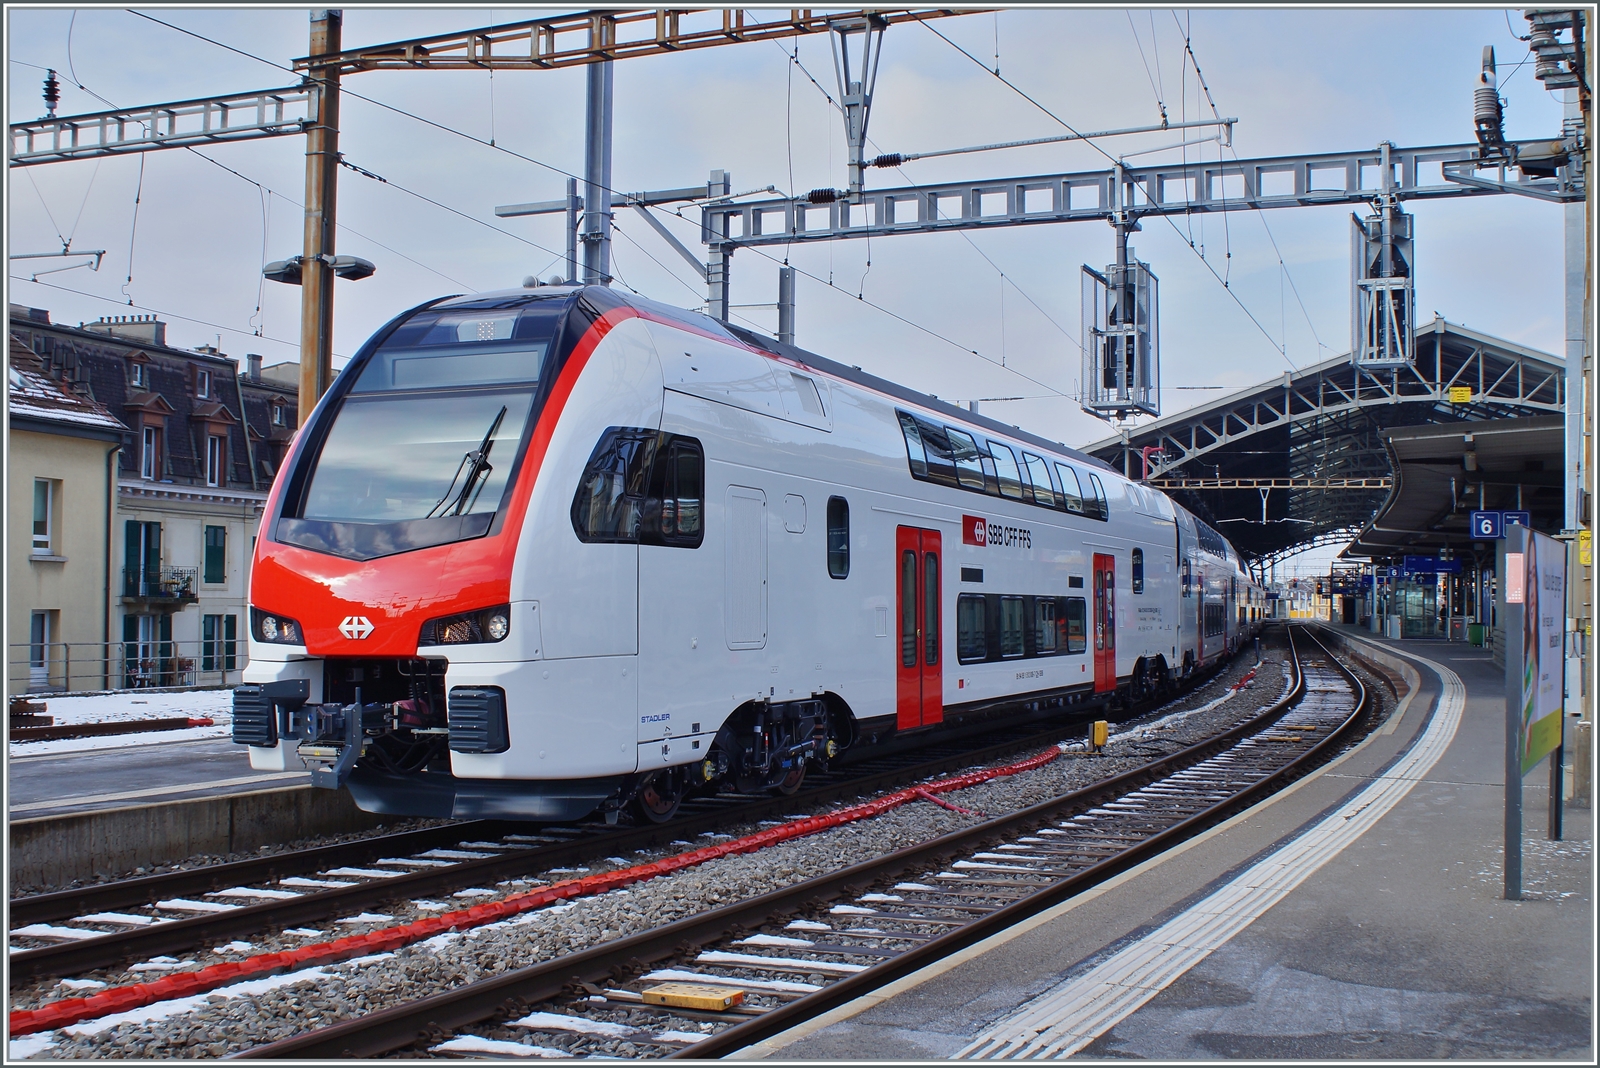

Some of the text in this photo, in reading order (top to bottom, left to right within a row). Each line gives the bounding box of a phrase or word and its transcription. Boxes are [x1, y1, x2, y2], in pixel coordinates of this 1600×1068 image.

[1481, 519, 1492, 535] 6
[988, 523, 1031, 550] SBB CFF FFS
[640, 713, 671, 723] STADLER
